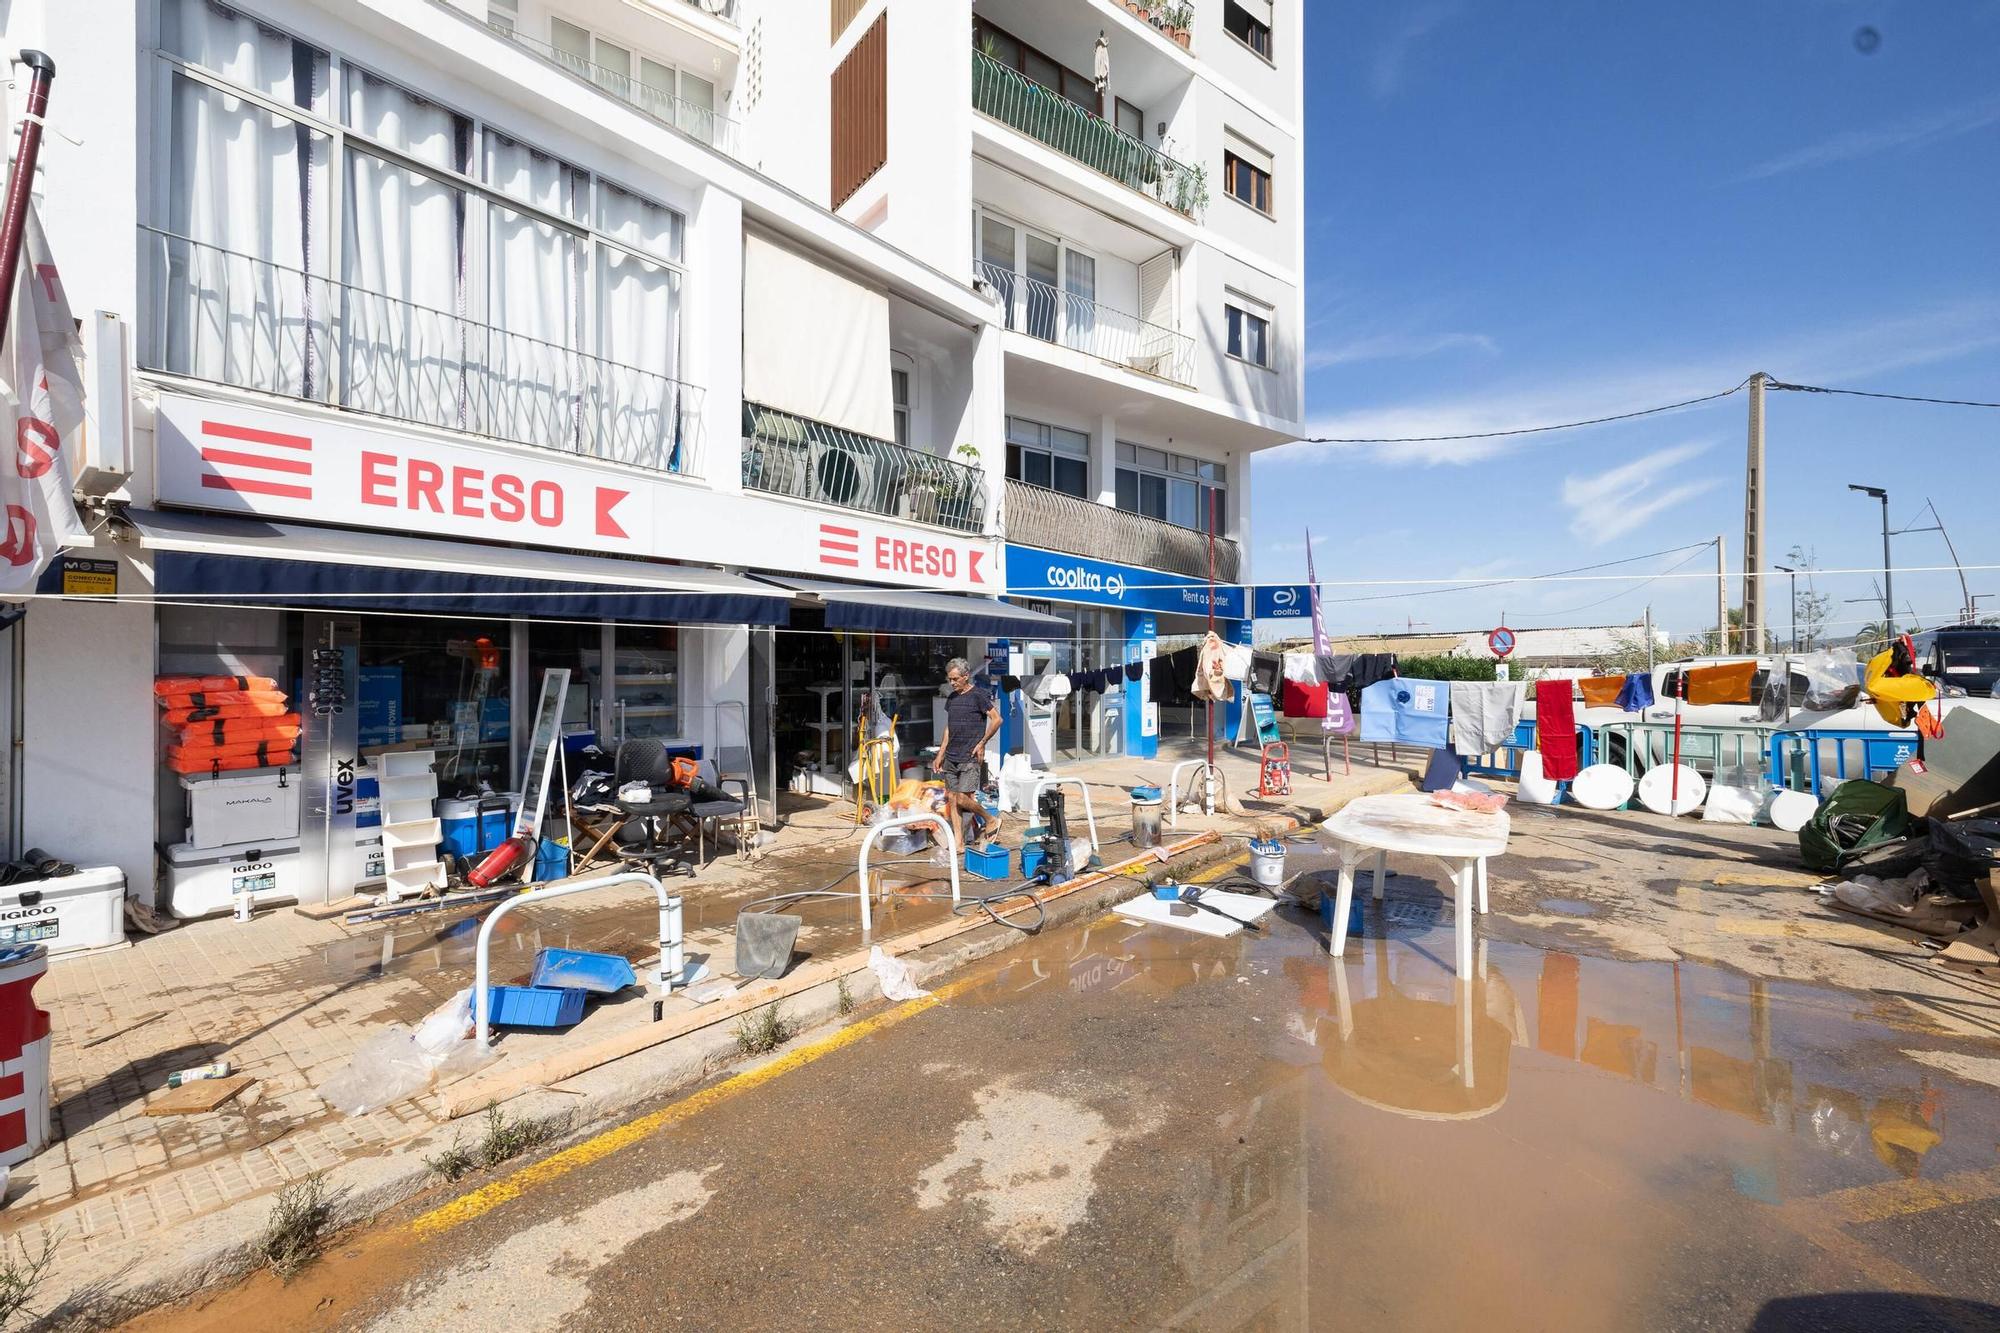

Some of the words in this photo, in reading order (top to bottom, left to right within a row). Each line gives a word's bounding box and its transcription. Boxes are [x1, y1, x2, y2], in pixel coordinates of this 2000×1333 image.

[361, 450, 564, 527] ERESO
[875, 535, 957, 578] ERESO
[1047, 565, 1101, 592] cooltra
[1182, 588, 1199, 603] Rent
[1200, 594, 1205, 604] a
[1031, 603, 1049, 615] ATM
[1272, 608, 1301, 616] cooltra
[989, 647, 1008, 657] TITAN
[388, 700, 396, 726] POWER
[336, 758, 354, 815] uvex
[233, 862, 273, 874] IGLOO
[1, 906, 57, 920] IGLOO
